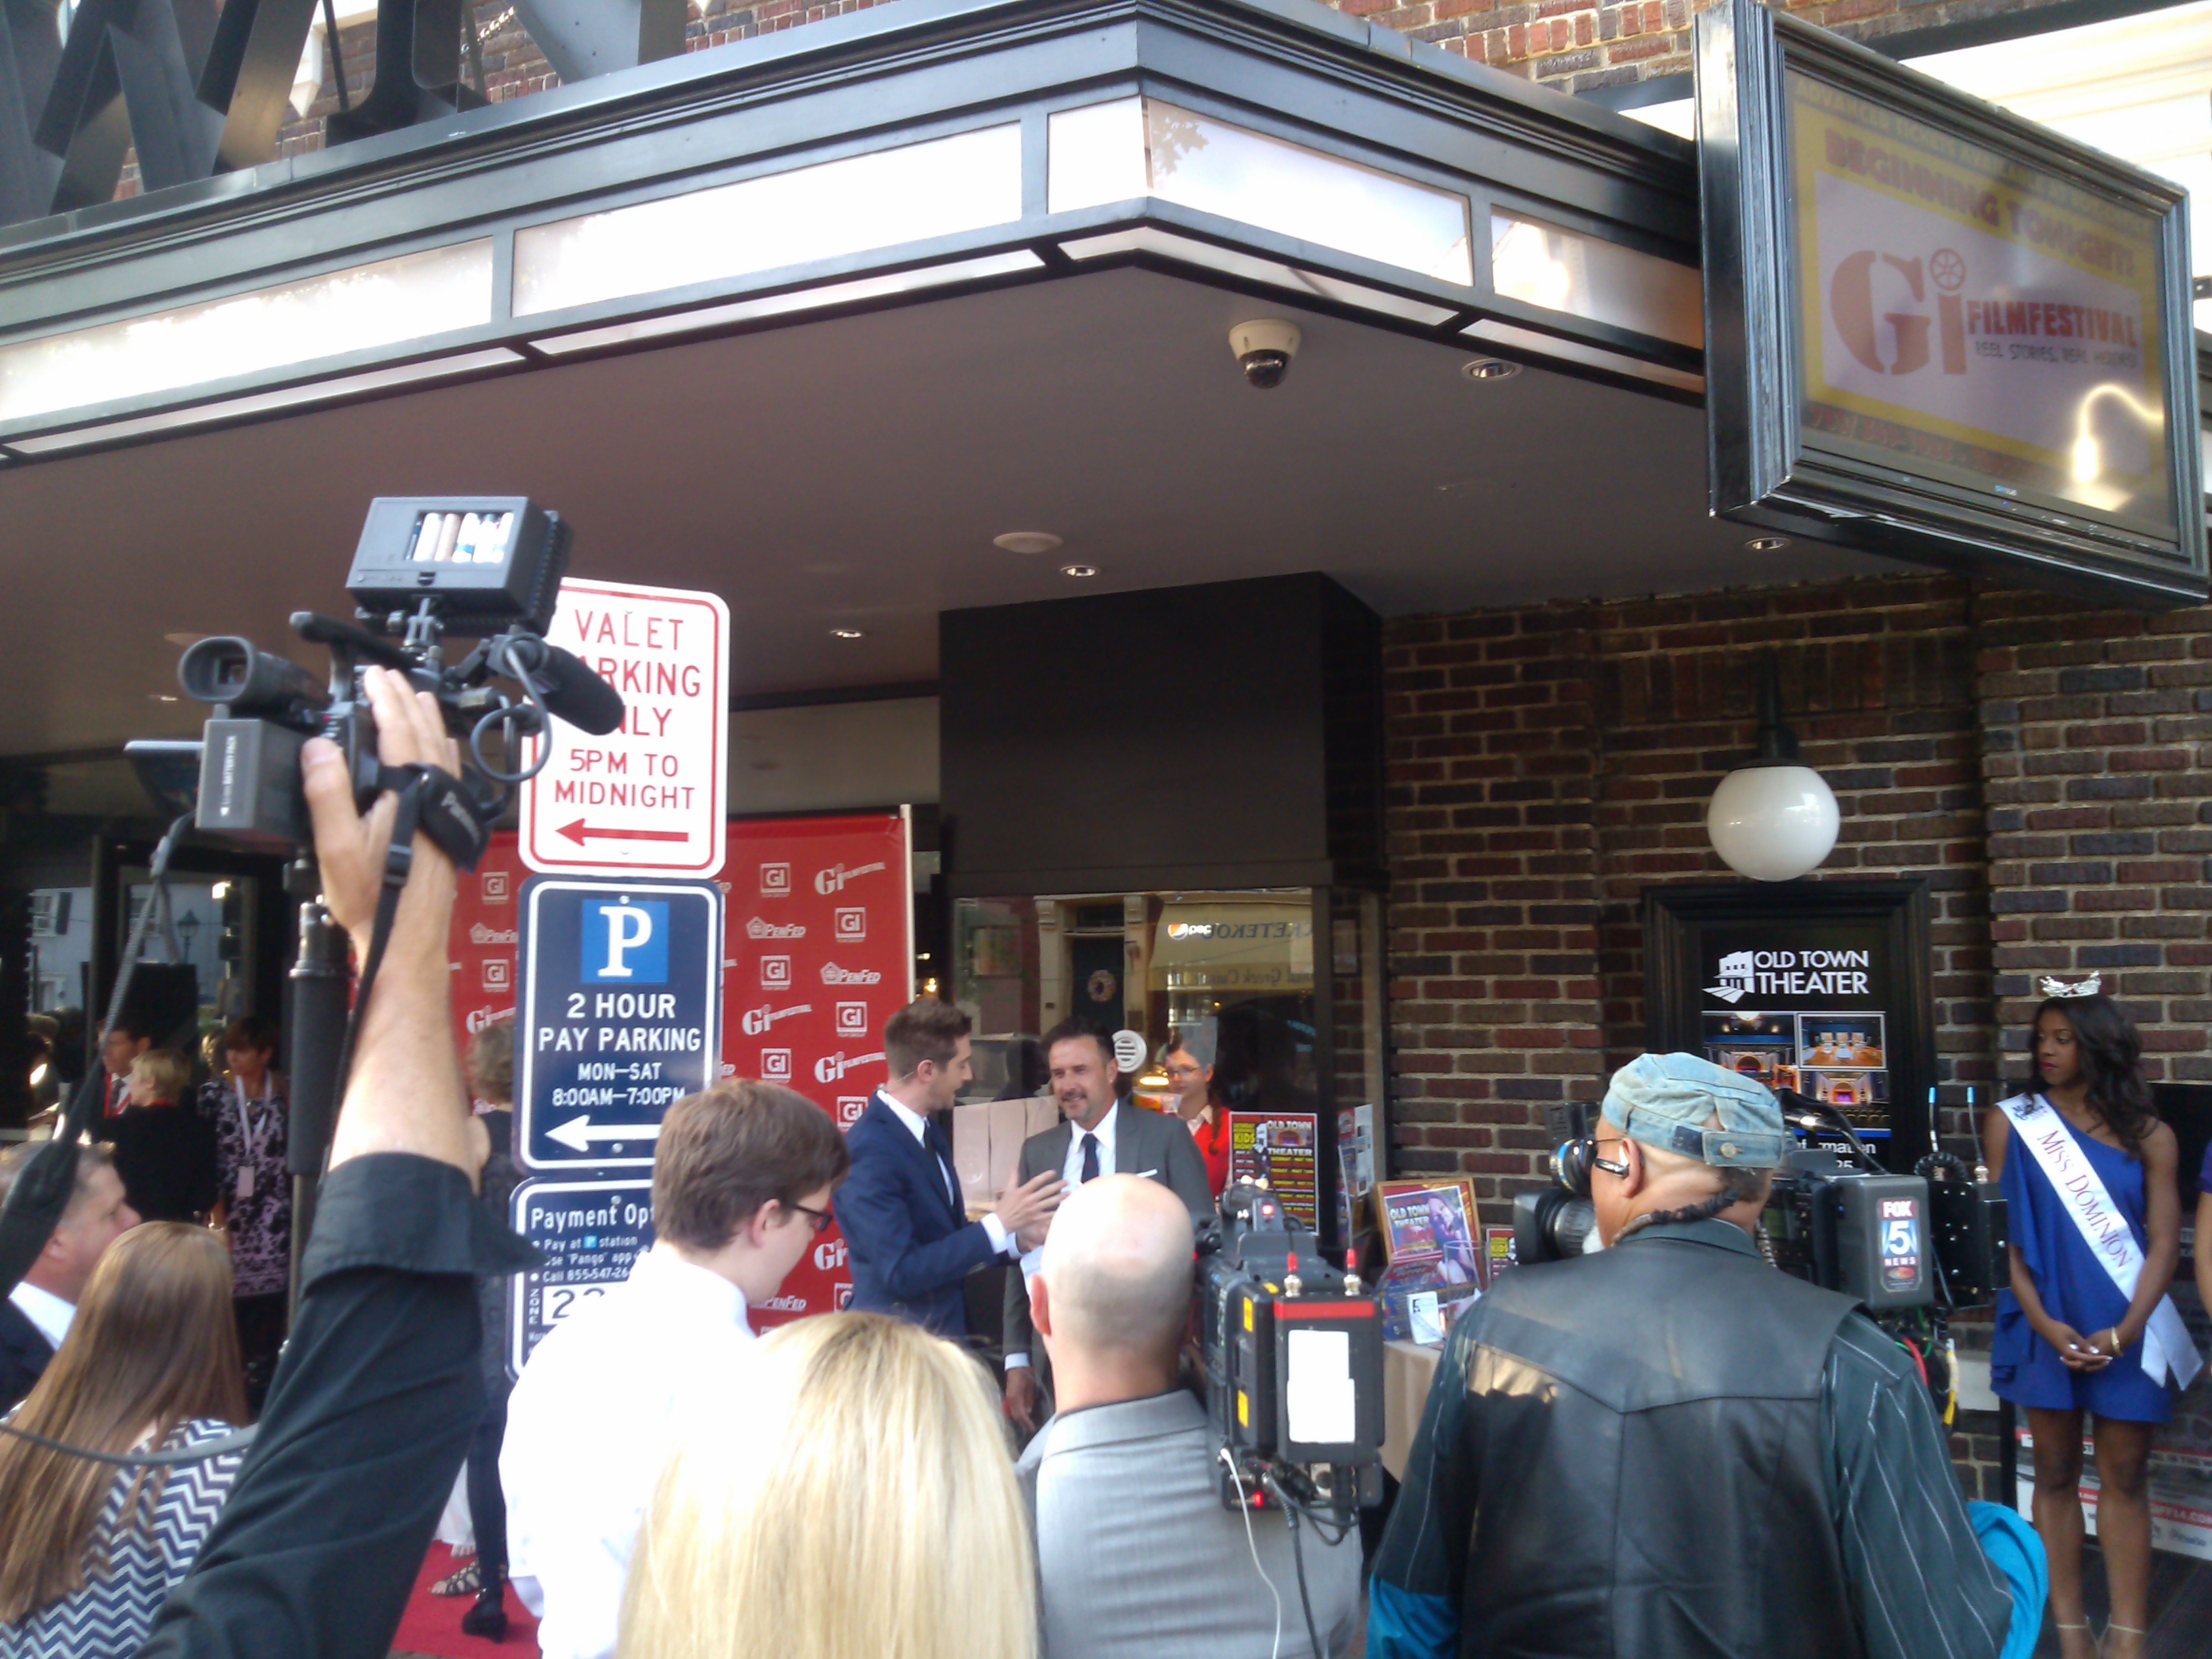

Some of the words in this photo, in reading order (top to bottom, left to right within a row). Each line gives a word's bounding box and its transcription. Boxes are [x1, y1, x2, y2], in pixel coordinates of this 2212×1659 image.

[1825, 127, 2000, 228] BEGINNING
[574, 609, 684, 651] VALET
[579, 655, 701, 697] RKING
[569, 748, 628, 775] 5PM
[644, 753, 678, 777] TO
[554, 779, 695, 810] MIDNIGHT
[597, 905, 653, 977] P
[1754, 949, 1796, 969] OLD
[1799, 949, 1870, 969] TOWN
[1755, 970, 1870, 995] THEATER
[567, 992, 587, 1018] 2
[595, 992, 676, 1019] HOUR
[538, 1027, 590, 1052] PAY
[598, 1027, 702, 1052] PARKING
[1267, 1120, 1285, 1130] OLD
[1267, 1147, 1313, 1157] THEATER
[530, 1204, 618, 1234] Payment
[1390, 1207, 1407, 1220] OLD
[1882, 1200, 1913, 1218] FOX
[2065, 1174, 2133, 1269] DOMINION
[544, 1238, 567, 1252] Pay
[569, 1237, 582, 1250] at
[598, 1235, 638, 1249] station
[1887, 1220, 1911, 1255] 5
[611, 1252, 633, 1265] app
[1883, 1256, 1917, 1267] NEWS
[542, 1269, 565, 1283] Call
[529, 1288, 541, 1325] ZONE
